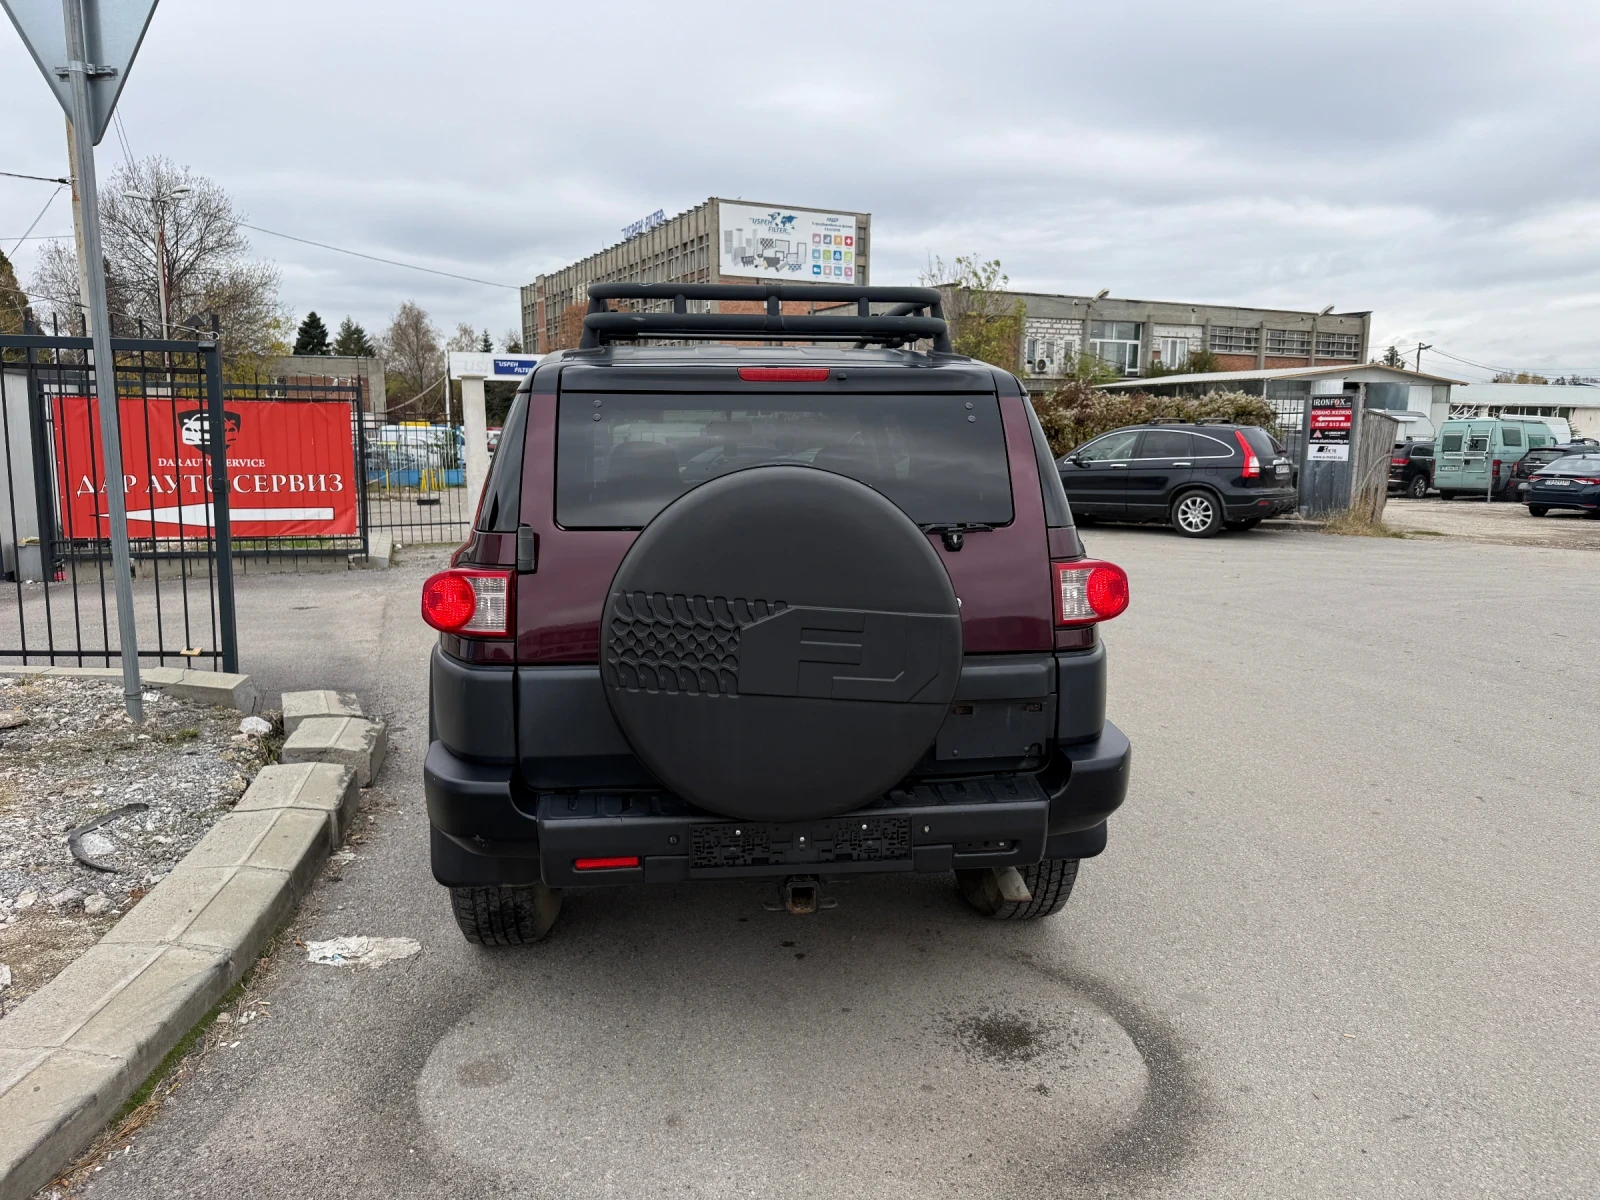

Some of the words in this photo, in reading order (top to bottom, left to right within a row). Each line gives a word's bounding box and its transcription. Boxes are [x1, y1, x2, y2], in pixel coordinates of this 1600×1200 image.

[768, 226, 788, 234] FILTER
[226, 458, 266, 468] ERVICE
[232, 473, 344, 493] СЕРВИЗ
